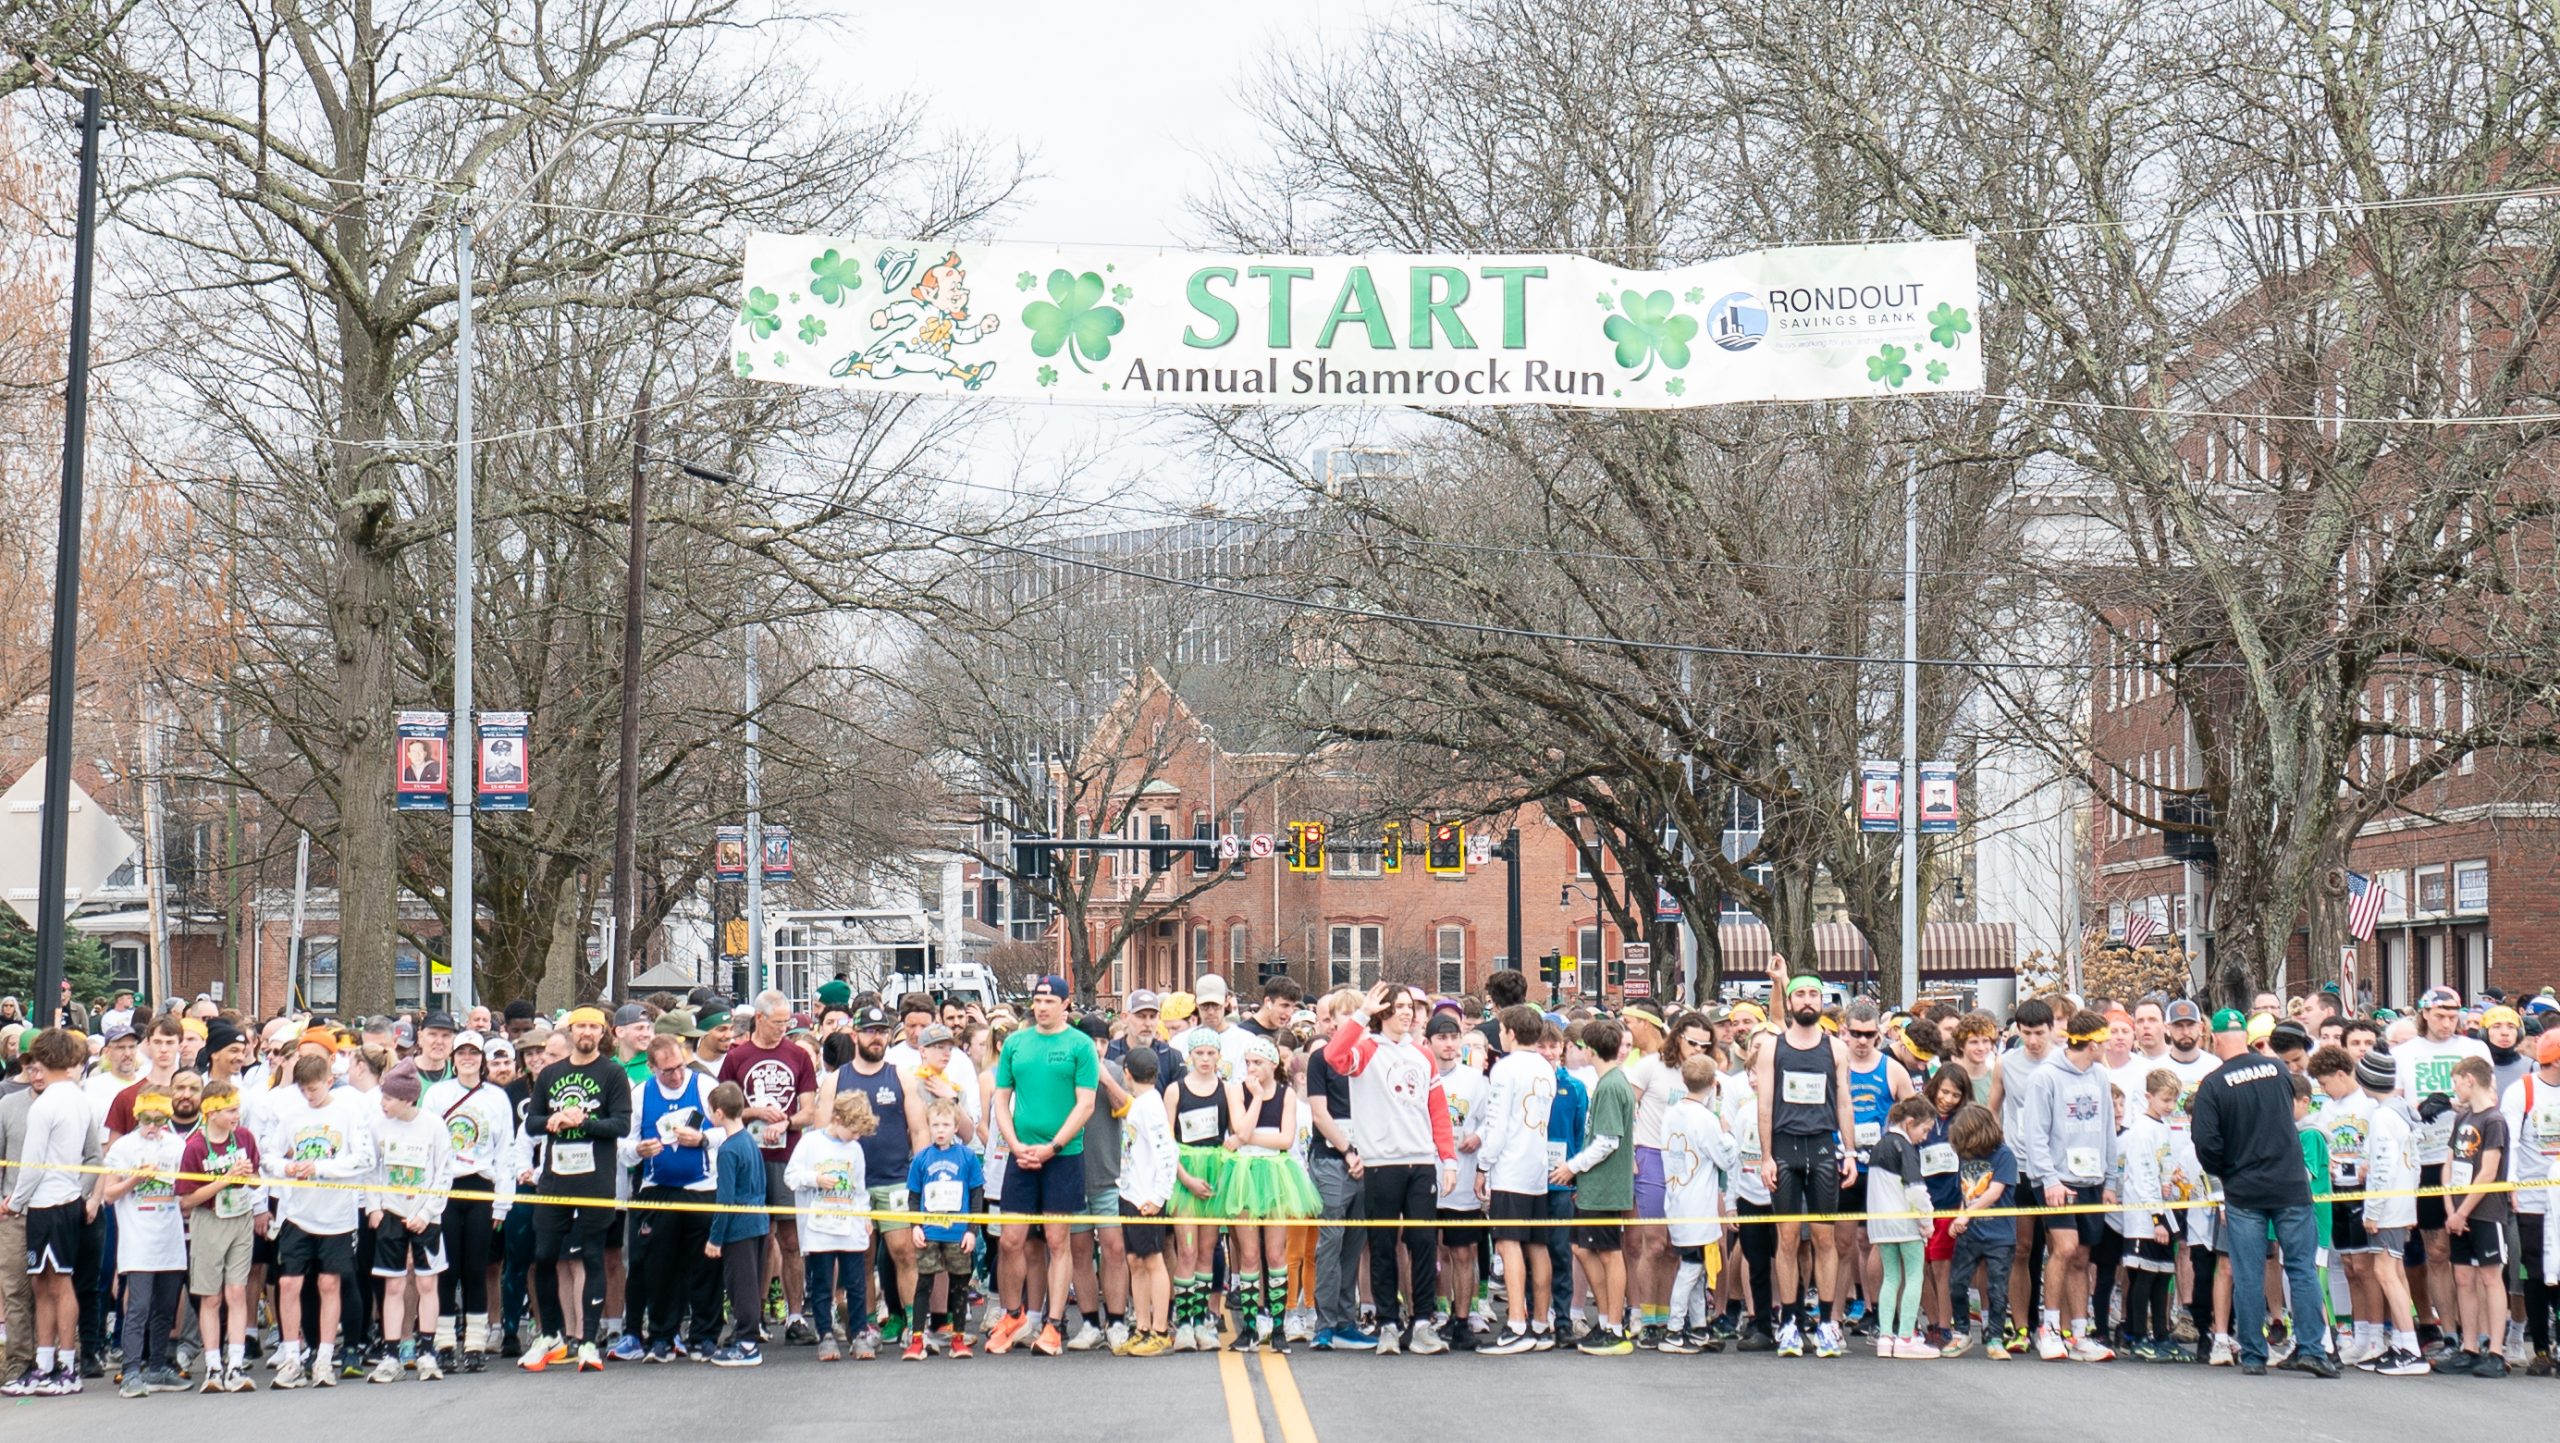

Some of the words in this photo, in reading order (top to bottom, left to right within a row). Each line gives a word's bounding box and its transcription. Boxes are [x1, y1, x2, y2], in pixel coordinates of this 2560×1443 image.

[1183, 266, 1547, 350] START
[1769, 284, 1924, 313] RONDOUT
[1779, 314, 1857, 330] SAVINGS
[1867, 312, 1916, 325] BANK
[1122, 356, 1277, 393] Annual
[1290, 356, 1510, 396] Shamrock
[1524, 360, 1605, 396] Run
[549, 1072, 584, 1097] LUCK
[583, 1077, 602, 1096] OF
[2223, 1063, 2278, 1087] FERRARO
